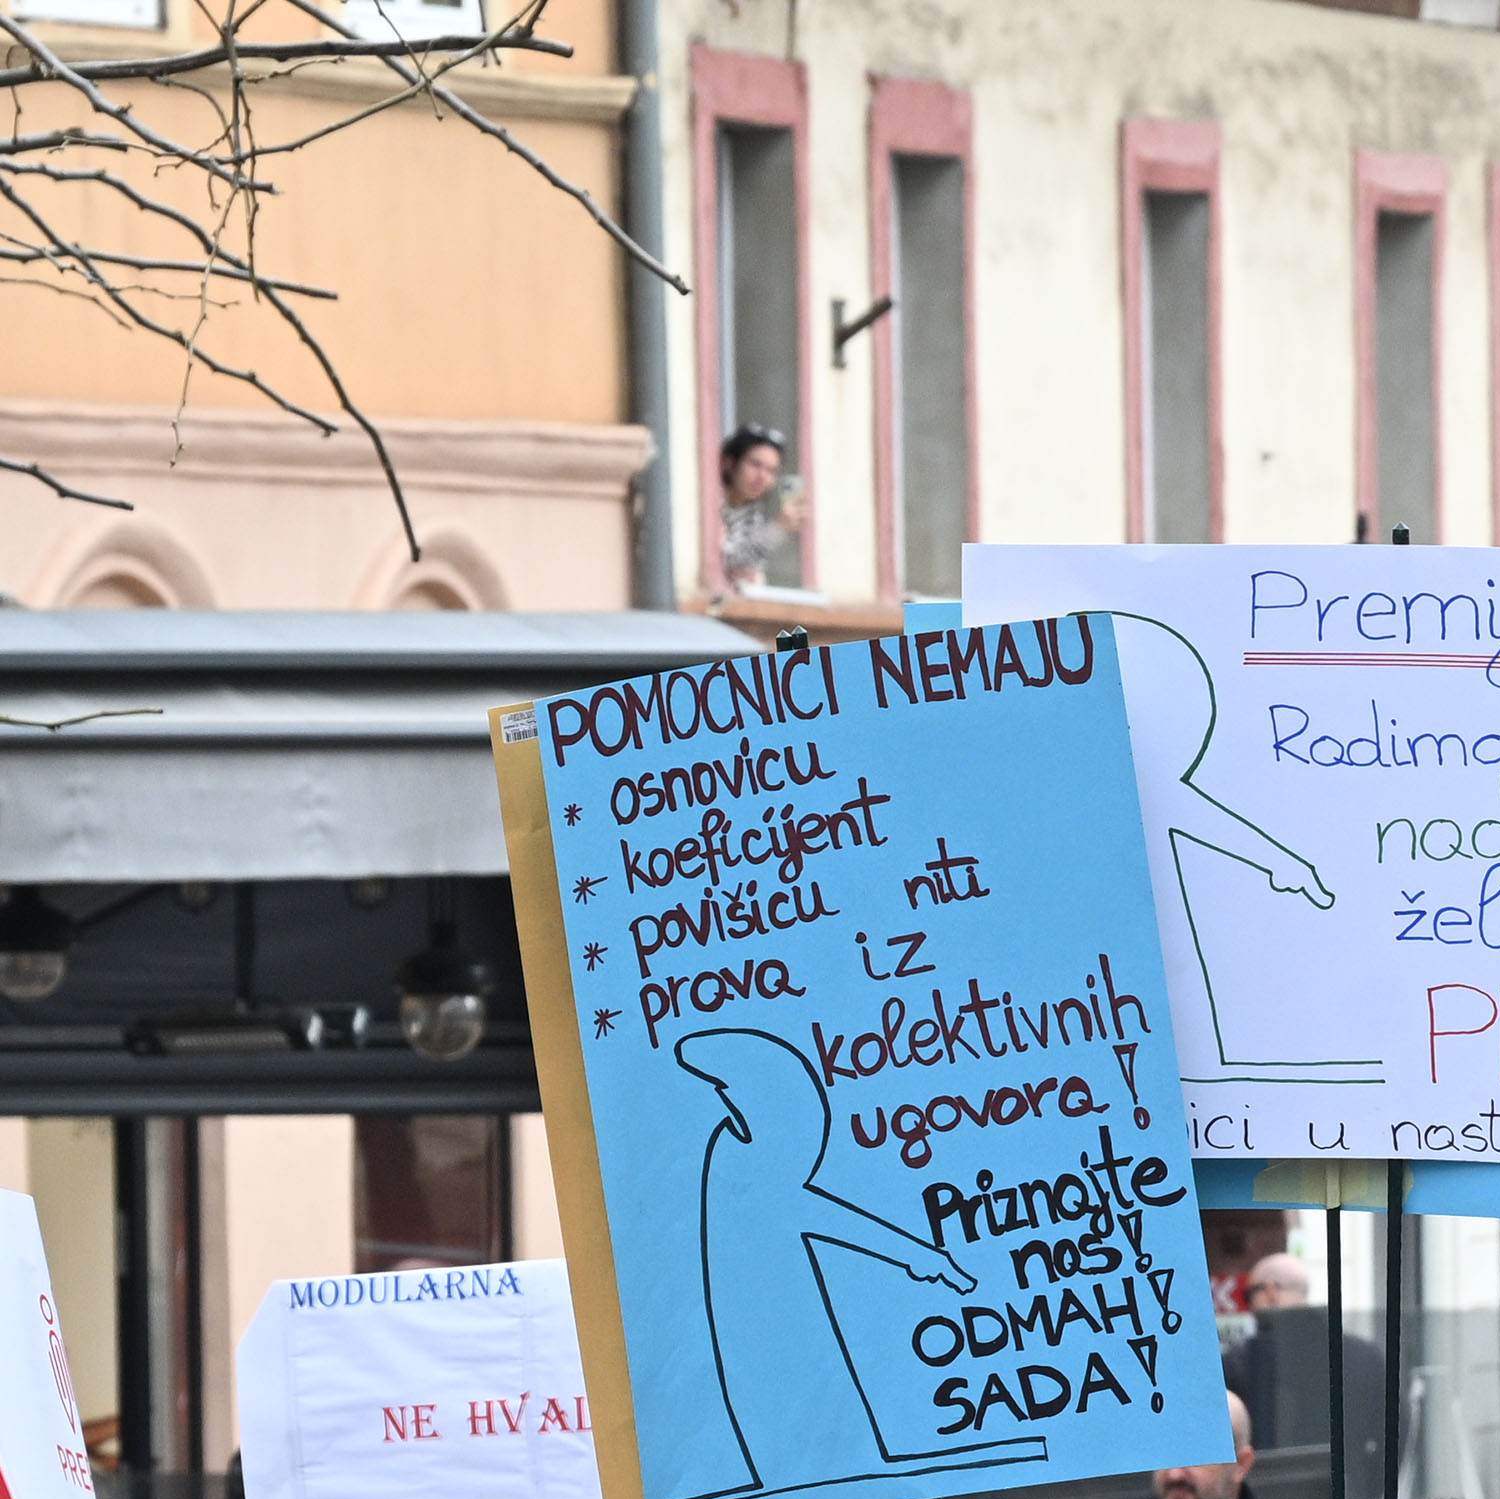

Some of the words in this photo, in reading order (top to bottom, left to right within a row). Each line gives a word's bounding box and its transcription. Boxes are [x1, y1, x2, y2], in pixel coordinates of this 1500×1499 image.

[869, 614, 1094, 708] NEMAJU
[609, 736, 836, 825] osnovicu
[620, 777, 891, 894] koeficijent
[629, 881, 839, 977] povišicu
[904, 837, 990, 910] niti
[638, 959, 805, 1048] prava
[856, 931, 936, 980] iz
[812, 953, 1150, 1088] kolektivnih
[1309, 1119, 1350, 1151] u
[922, 1126, 1187, 1247] Priznajte
[288, 1266, 525, 1311] MODULARNA
[911, 1269, 1182, 1368] ODMAH!
[382, 1403, 441, 1443] NE
[932, 1335, 1164, 1436] SADA!
